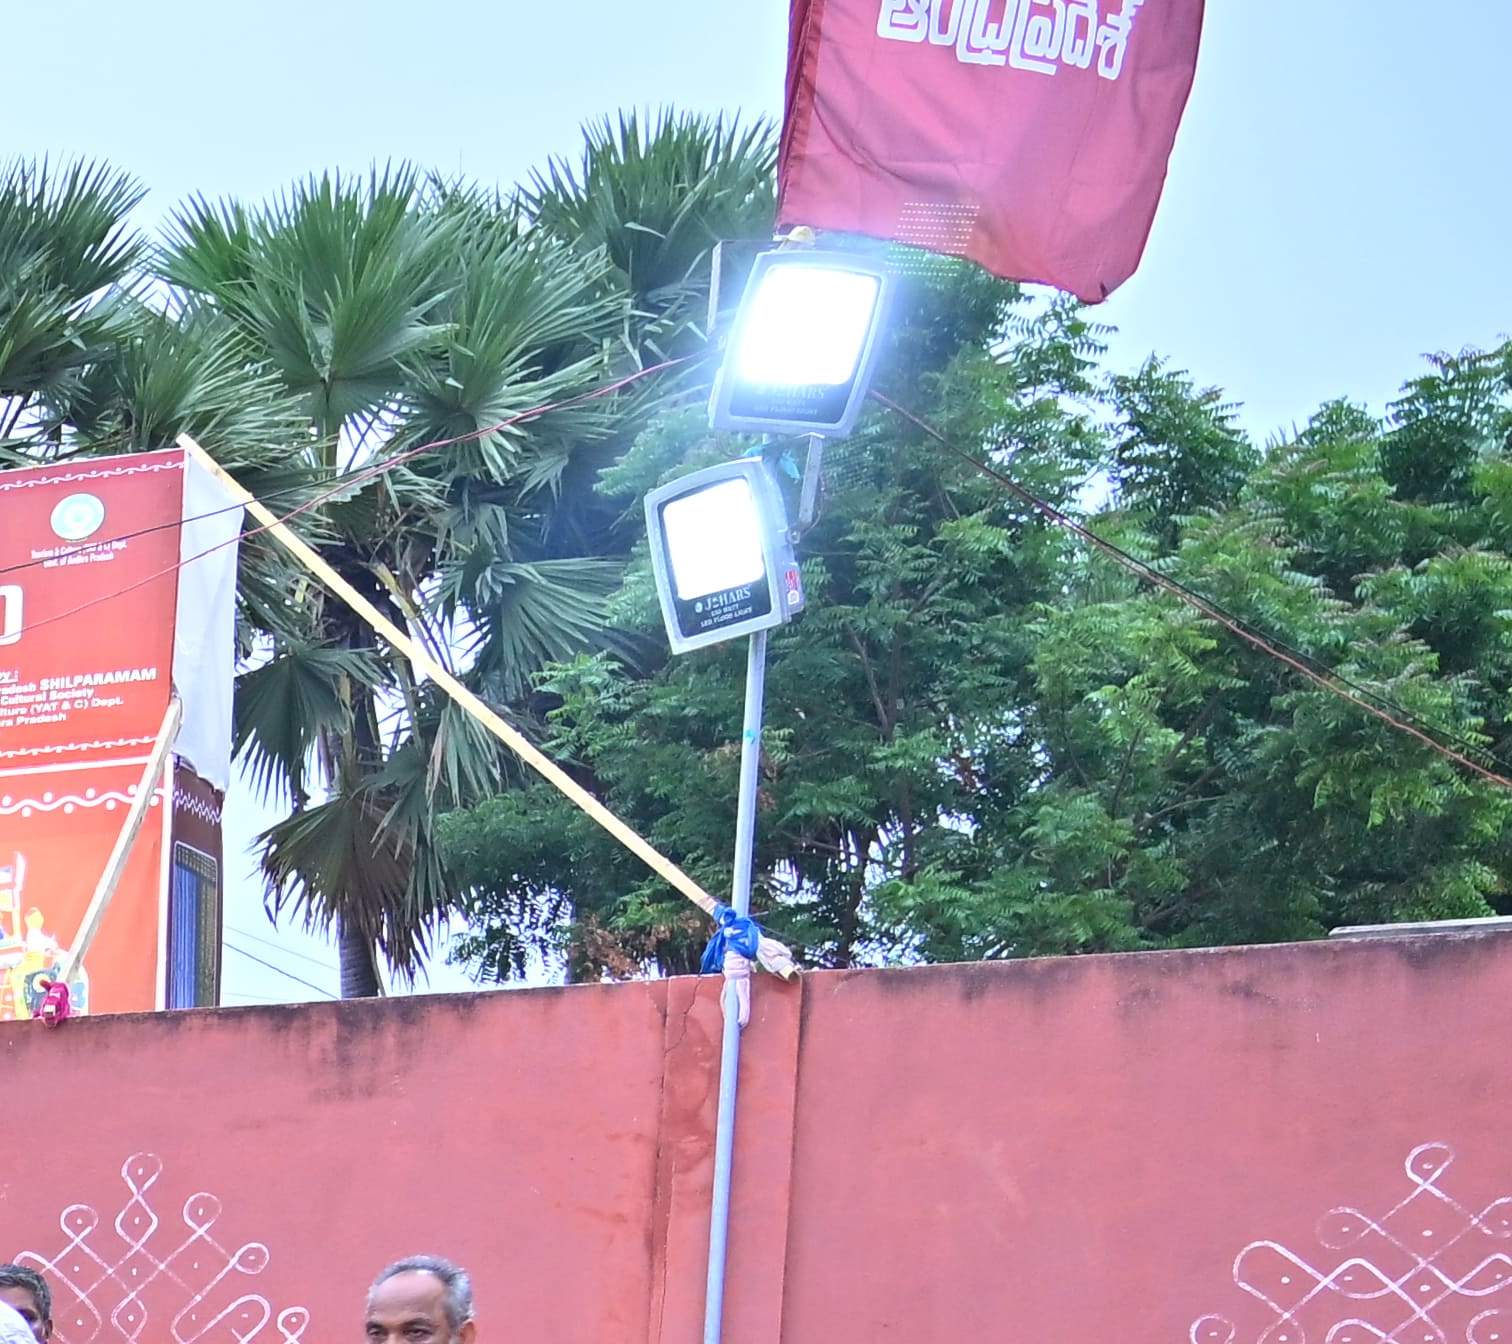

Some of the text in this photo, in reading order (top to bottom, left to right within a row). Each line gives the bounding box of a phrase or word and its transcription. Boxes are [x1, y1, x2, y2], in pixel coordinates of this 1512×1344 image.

[39, 668, 157, 691] SHILPARAMAM
[1, 693, 46, 707] Cultural
[49, 688, 94, 702] Society
[91, 695, 124, 709] Dept.
[17, 713, 66, 727] Pradesh
